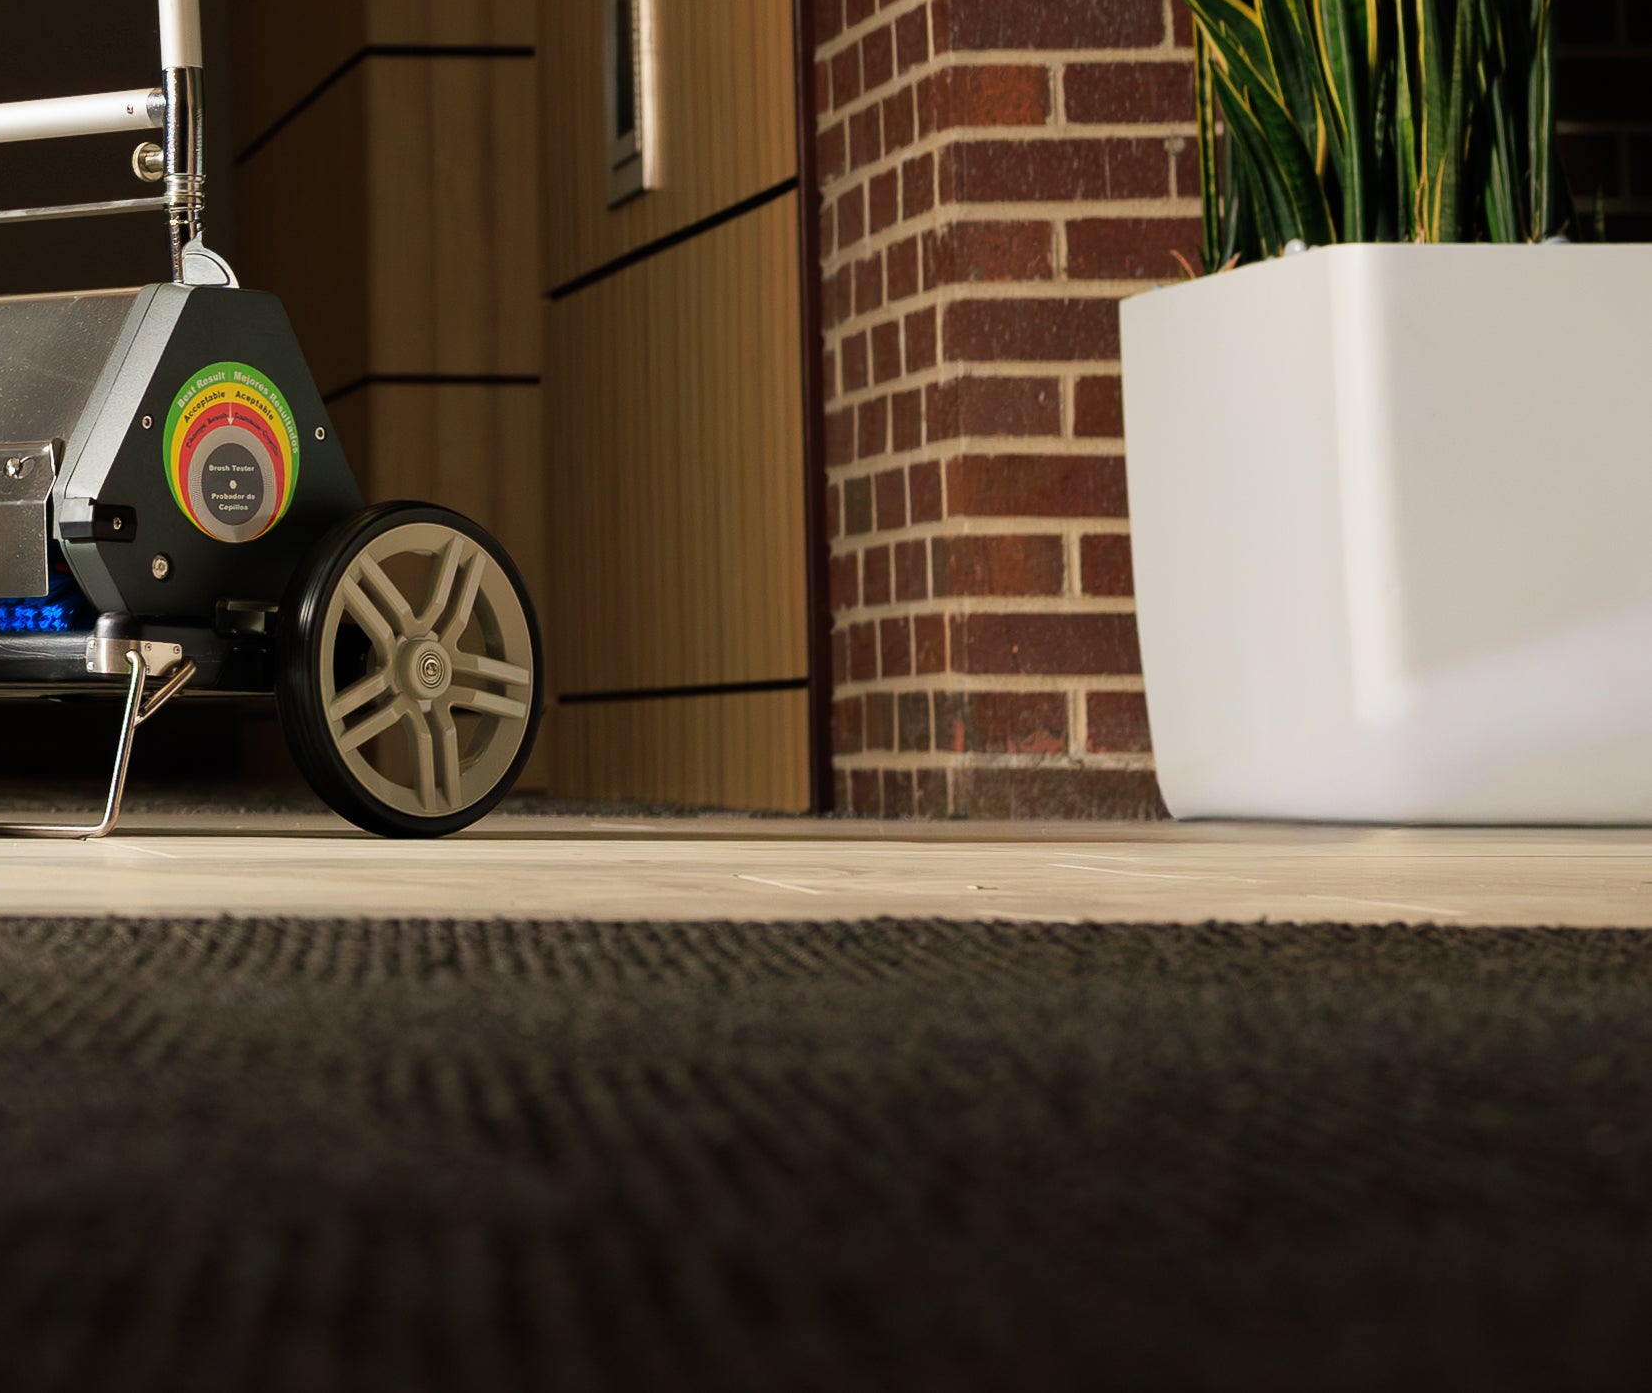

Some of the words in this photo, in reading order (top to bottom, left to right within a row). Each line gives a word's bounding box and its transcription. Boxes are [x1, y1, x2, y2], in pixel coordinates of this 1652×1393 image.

[177, 385, 197, 409] Best
[196, 371, 226, 389] Result
[184, 390, 226, 424] Acceptable
[235, 390, 274, 421] Aceptable
[233, 371, 268, 396] Mejores
[269, 393, 299, 454] Resultados
[208, 464, 231, 472] Brush
[231, 464, 255, 472] Tester
